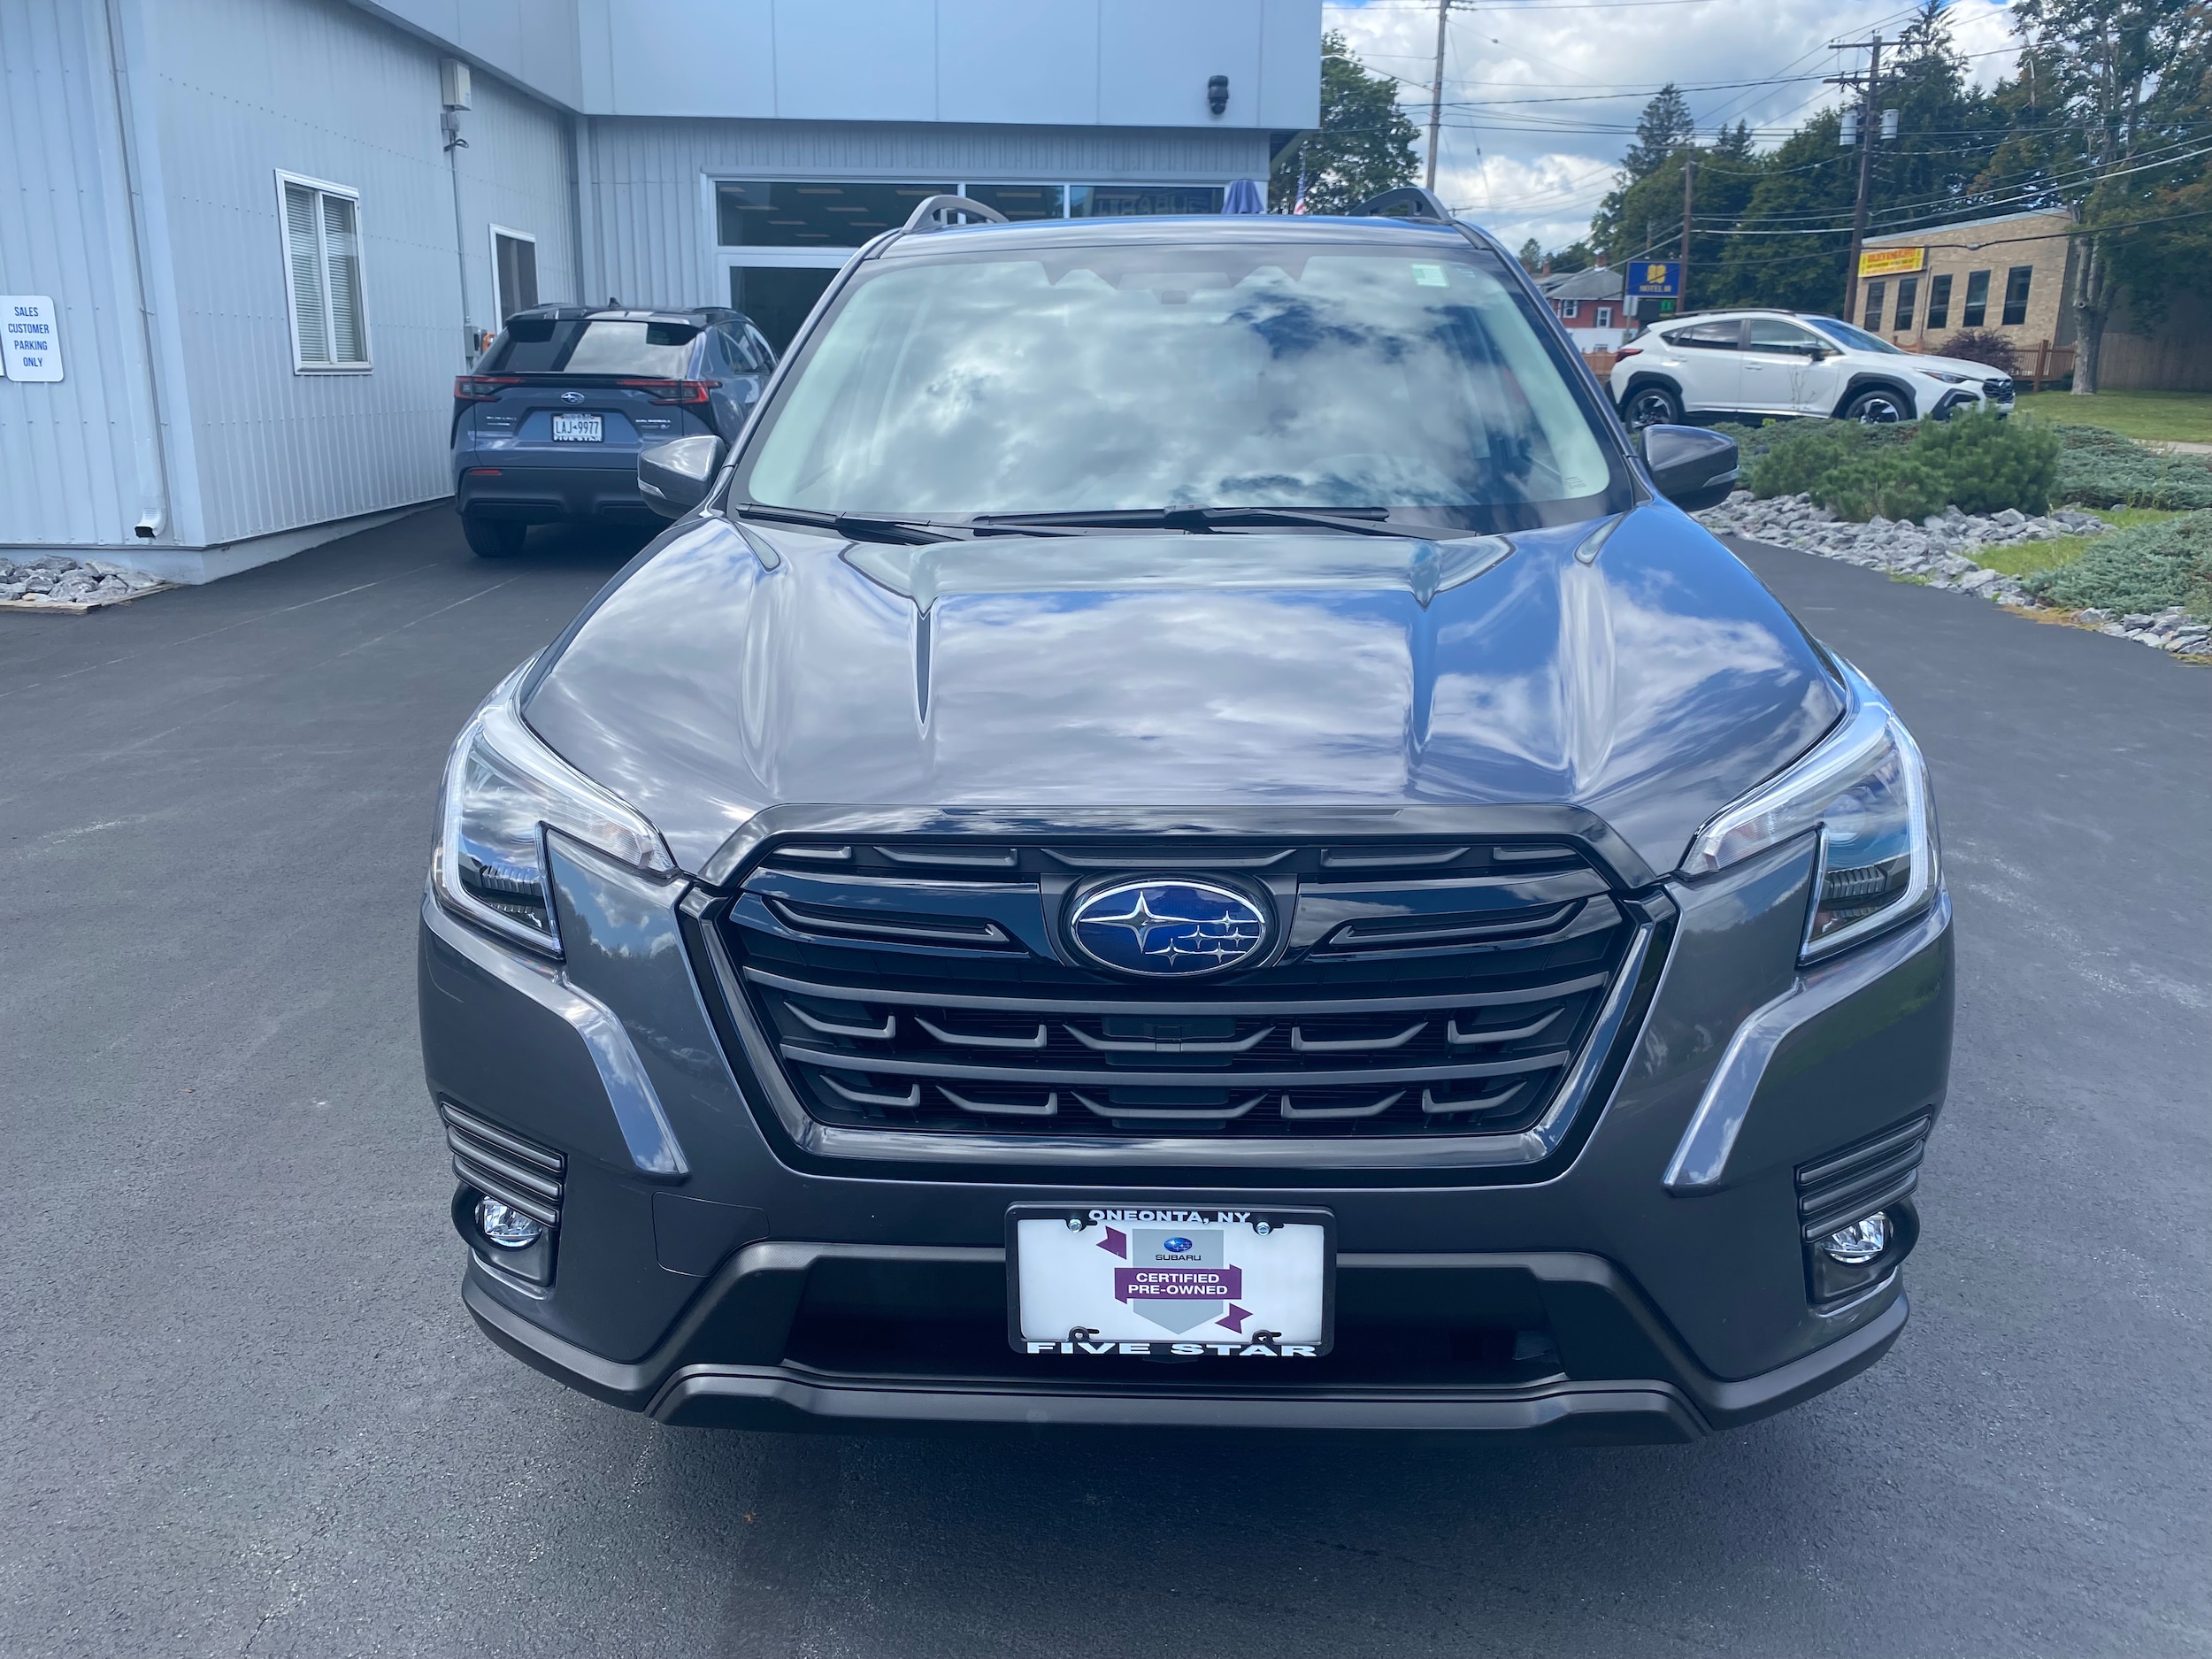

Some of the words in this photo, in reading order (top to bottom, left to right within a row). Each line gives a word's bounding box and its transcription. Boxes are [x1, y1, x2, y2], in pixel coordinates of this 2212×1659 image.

[14, 306, 39, 317] SALES
[8, 323, 50, 334] CUSTOMER
[14, 340, 48, 350] PARKING
[23, 357, 42, 367] ONLY
[556, 420, 572, 434] LAJ
[578, 421, 599, 434] 9977
[1088, 1210, 1210, 1225] ONEONTA,
[1217, 1211, 1251, 1223] NY
[1135, 1272, 1220, 1283] CERTIFIED
[1128, 1284, 1228, 1295] PRE-OWNED
[1026, 1341, 1151, 1356] FIVE
[1170, 1343, 1317, 1357] STAR
